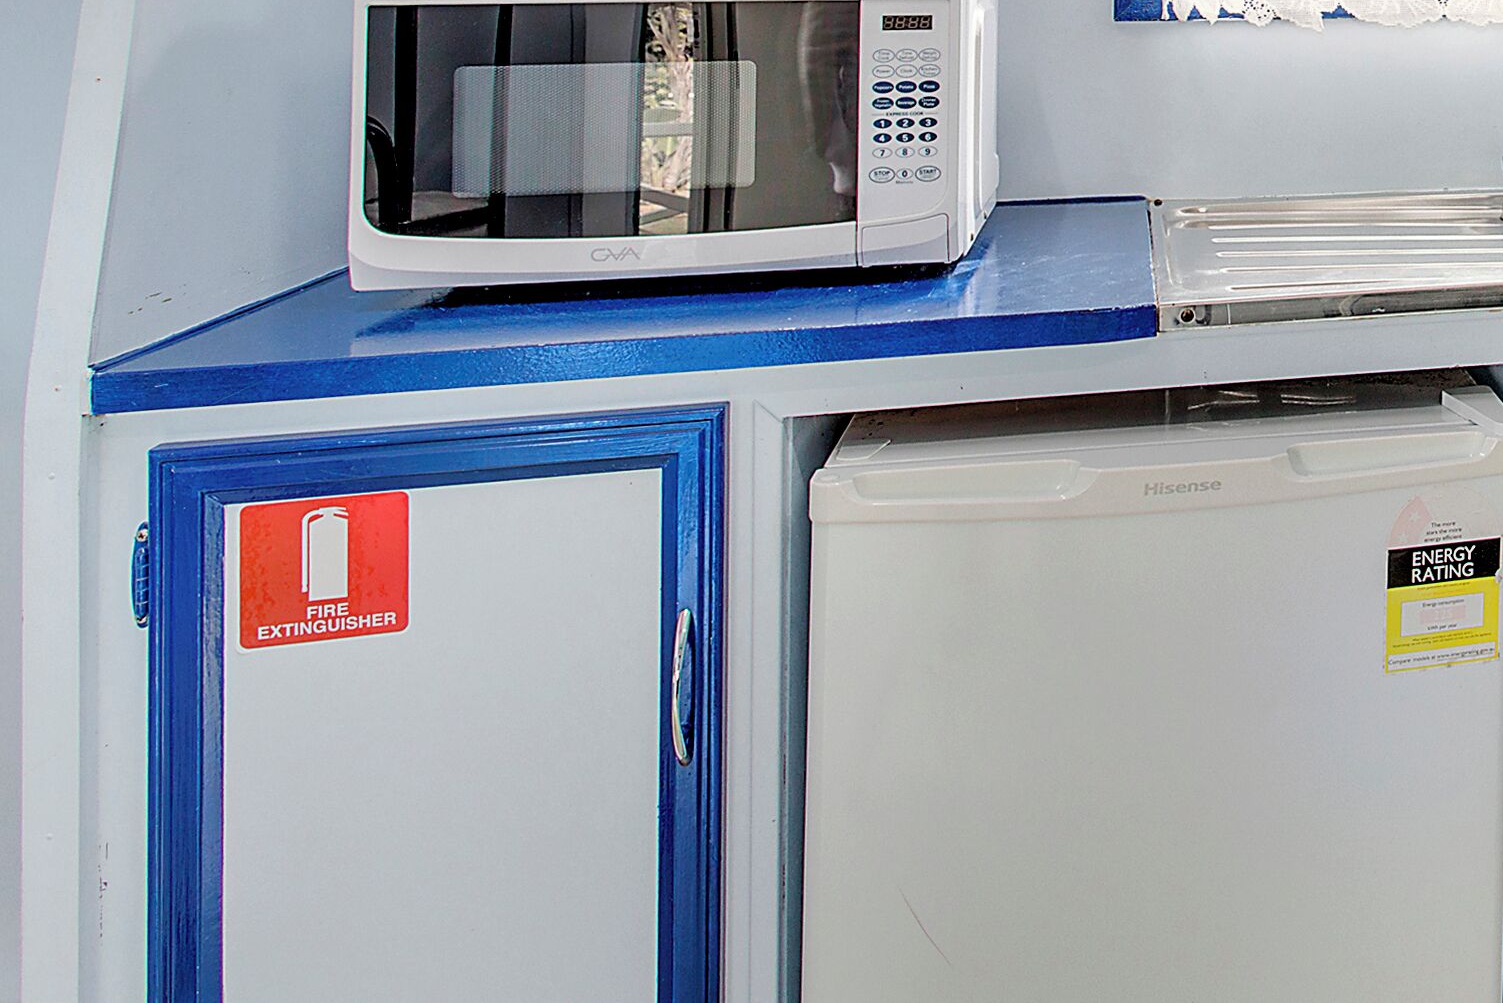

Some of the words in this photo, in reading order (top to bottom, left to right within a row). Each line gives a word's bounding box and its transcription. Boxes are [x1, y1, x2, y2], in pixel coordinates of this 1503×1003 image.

[880, 120, 885, 128] 1
[902, 119, 909, 127] 2
[925, 118, 931, 127] 3
[879, 134, 885, 142] 4
[902, 134, 909, 142] 5
[925, 133, 931, 141] 6
[880, 149, 885, 157] 7
[902, 148, 908, 156] 8
[925, 148, 931, 156] 9
[1144, 480, 1222, 496] Hisense
[1412, 544, 1476, 567] ENERGY
[1411, 562, 1474, 584] RATING
[306, 602, 350, 619] FIRE
[257, 612, 397, 640] EXTINGUISHER
